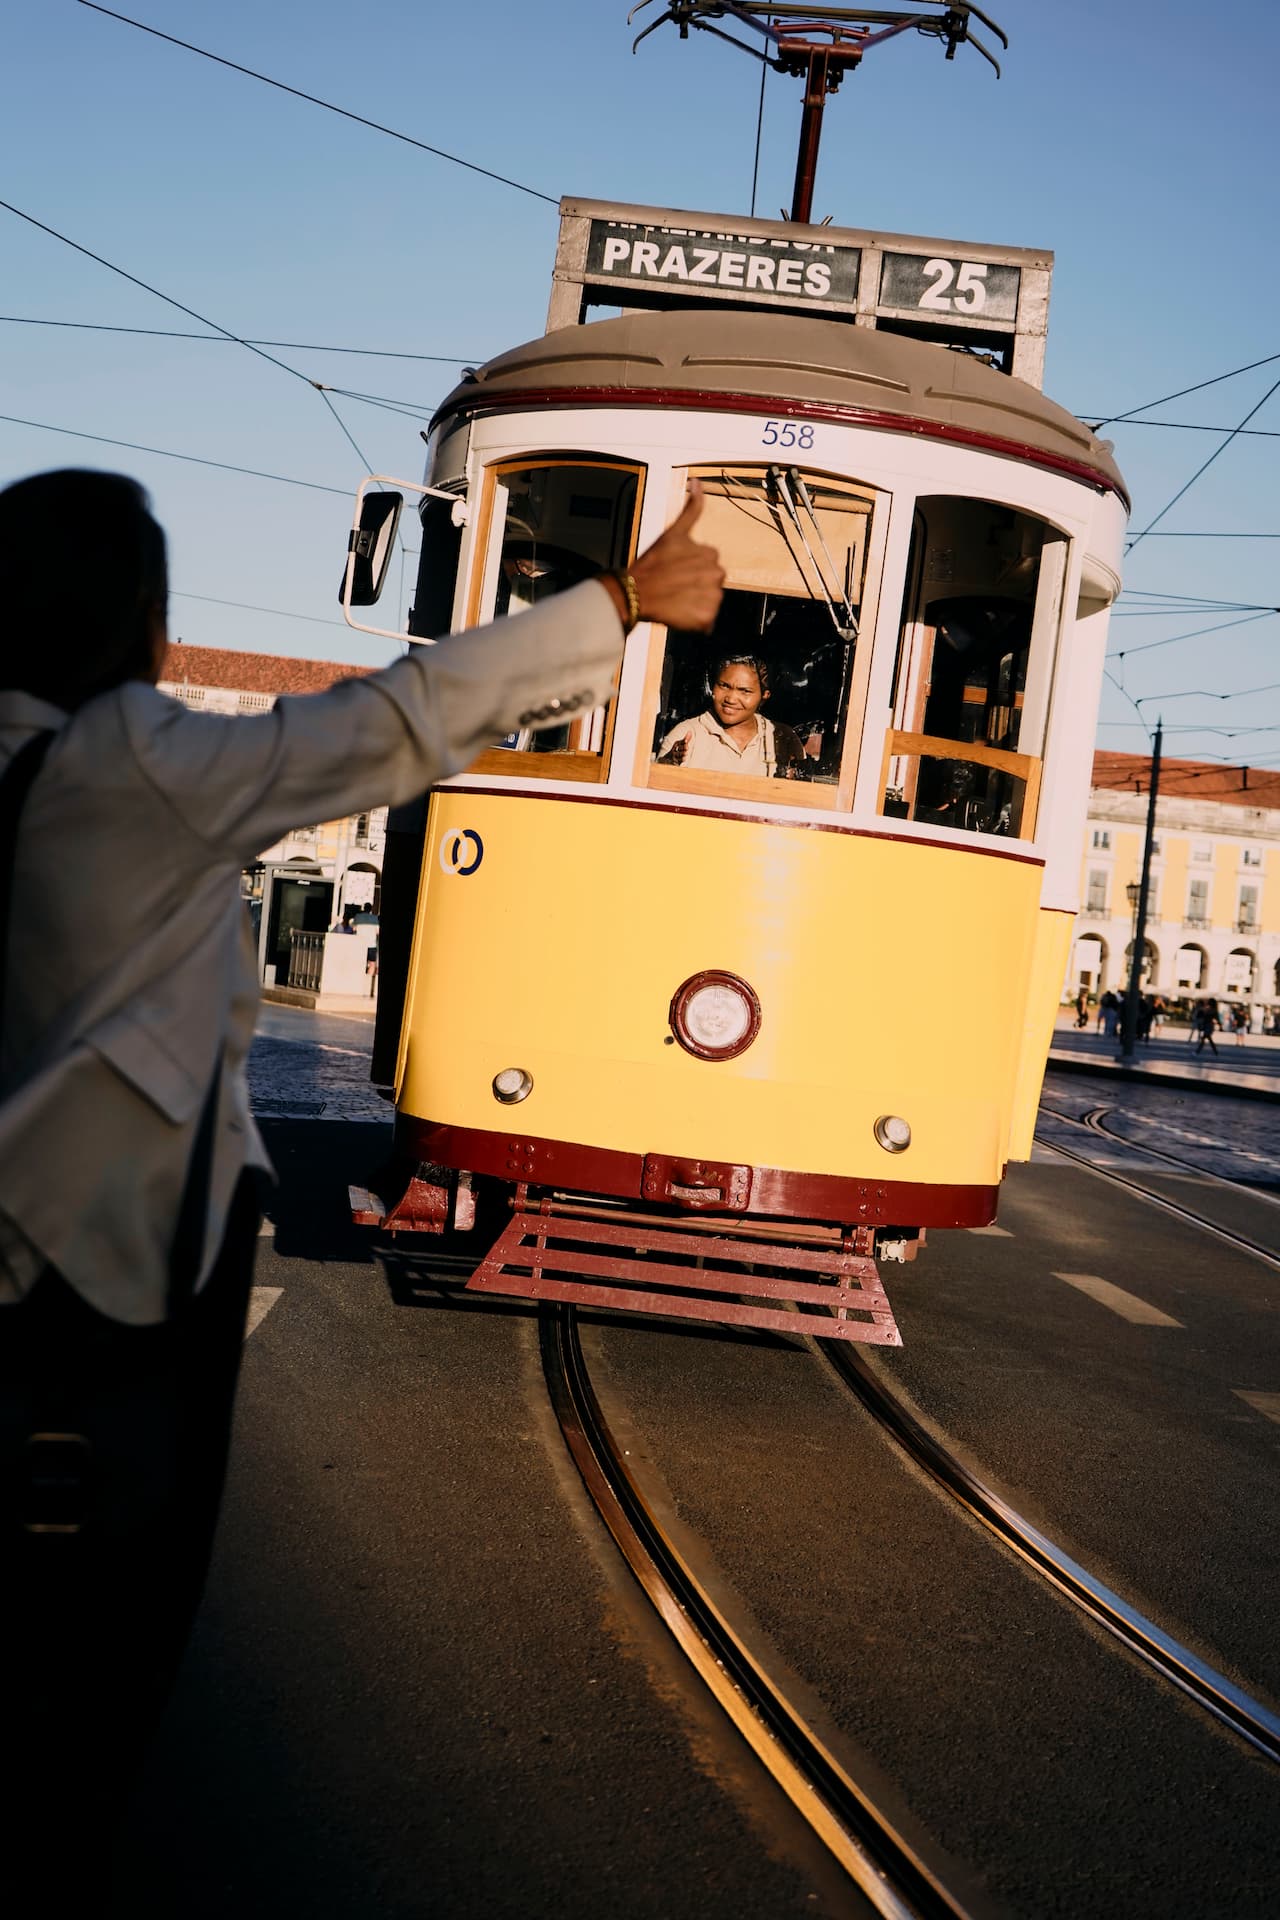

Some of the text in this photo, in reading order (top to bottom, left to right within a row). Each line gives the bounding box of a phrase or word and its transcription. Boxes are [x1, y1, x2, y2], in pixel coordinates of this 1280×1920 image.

[602, 237, 832, 297] PRAZERES
[918, 258, 988, 314] 25
[762, 421, 814, 449] 558
